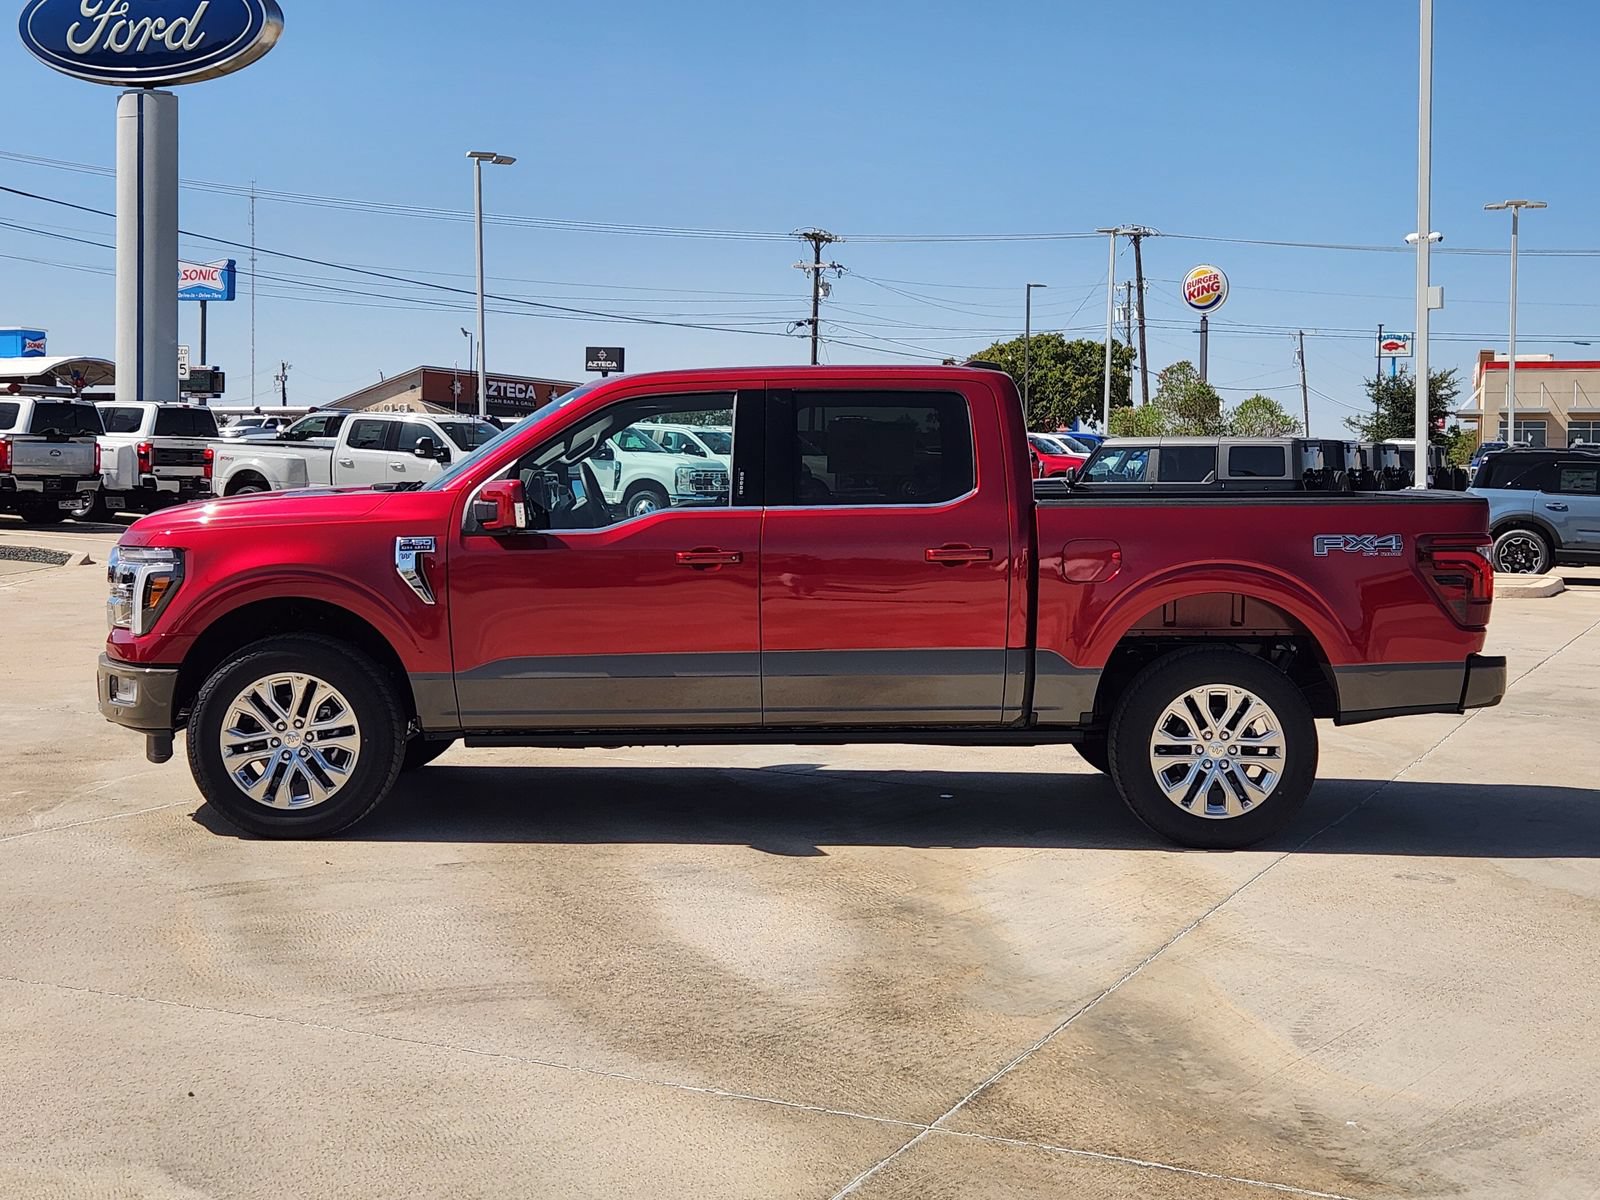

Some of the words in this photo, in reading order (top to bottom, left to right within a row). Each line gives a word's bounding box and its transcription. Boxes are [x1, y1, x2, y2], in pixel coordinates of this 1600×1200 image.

[66, 0, 208, 54] Ford
[181, 269, 218, 281] SONIC
[1187, 274, 1219, 290] BURGER
[1188, 281, 1220, 301] KING
[478, 381, 536, 399] ZTECA
[1313, 534, 1403, 556] FX4
